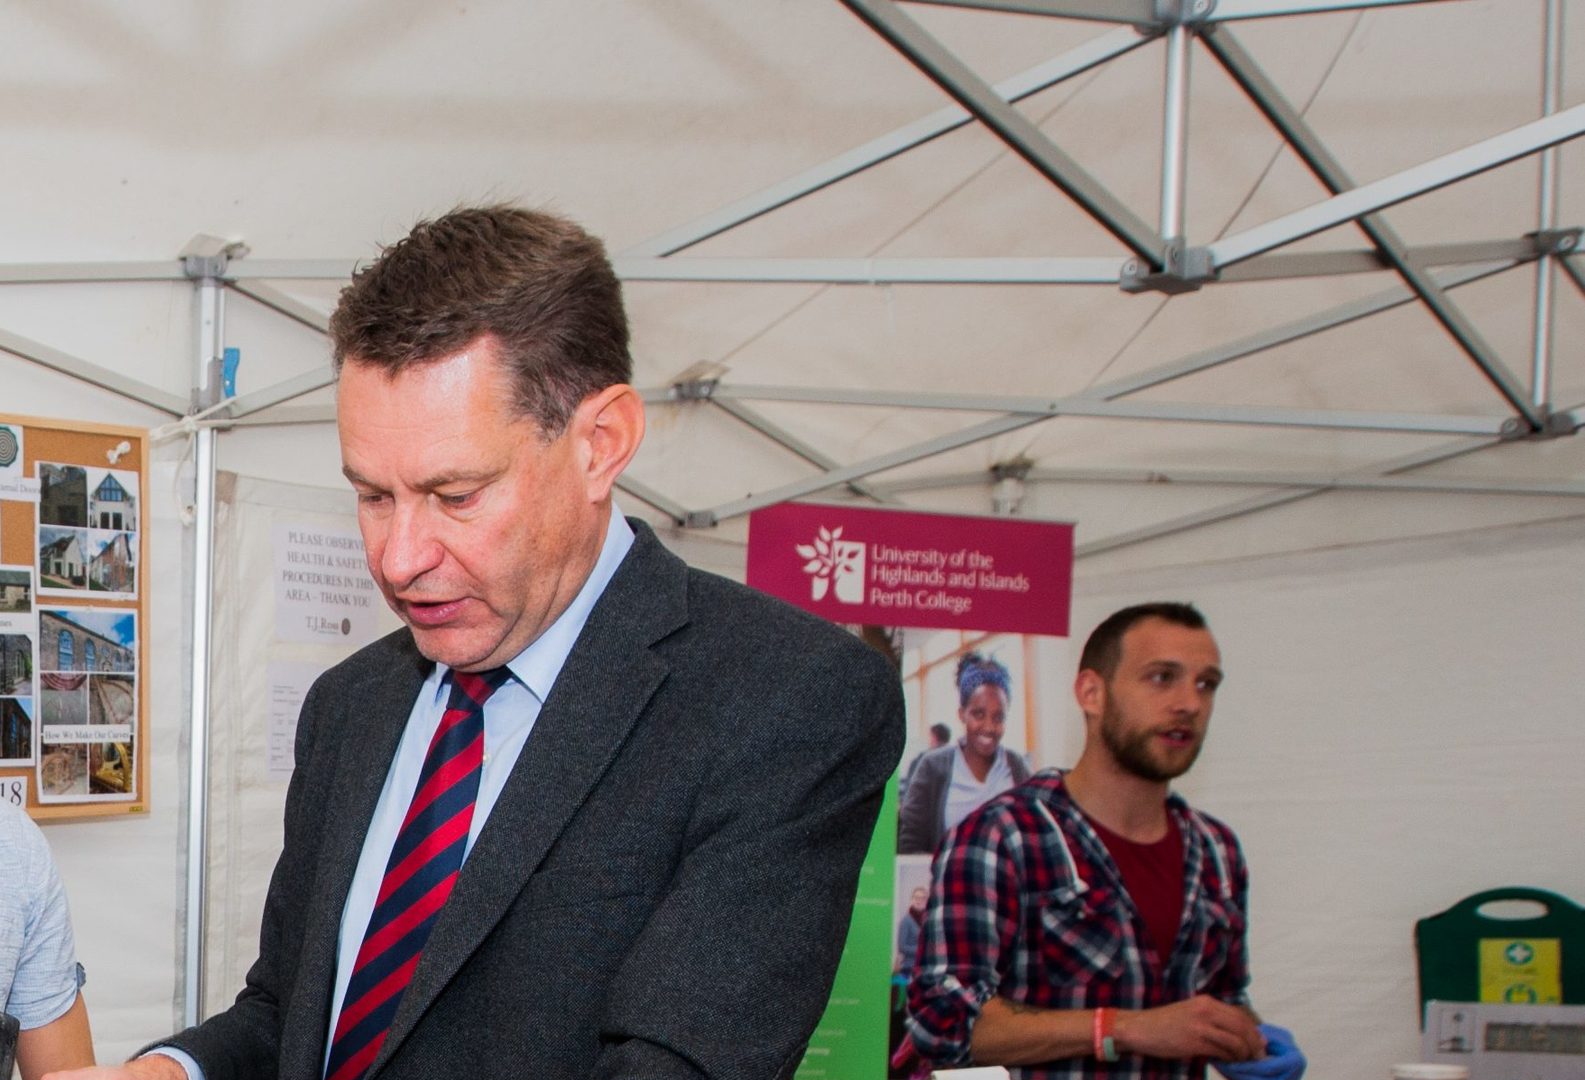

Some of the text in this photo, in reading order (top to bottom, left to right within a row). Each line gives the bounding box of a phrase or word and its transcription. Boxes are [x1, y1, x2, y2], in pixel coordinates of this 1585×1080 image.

[288, 531, 323, 546] PLEASE
[287, 551, 325, 566] HEALTH
[327, 557, 334, 566] &
[871, 544, 994, 570] University of the
[282, 569, 343, 587] PROCEDURES
[344, 576, 354, 588] IN
[871, 565, 1030, 592] Highlands and Islands
[285, 589, 311, 602] AREA
[320, 591, 351, 606] THANK
[352, 595, 370, 608] YOU
[871, 588, 973, 614] Perth College
